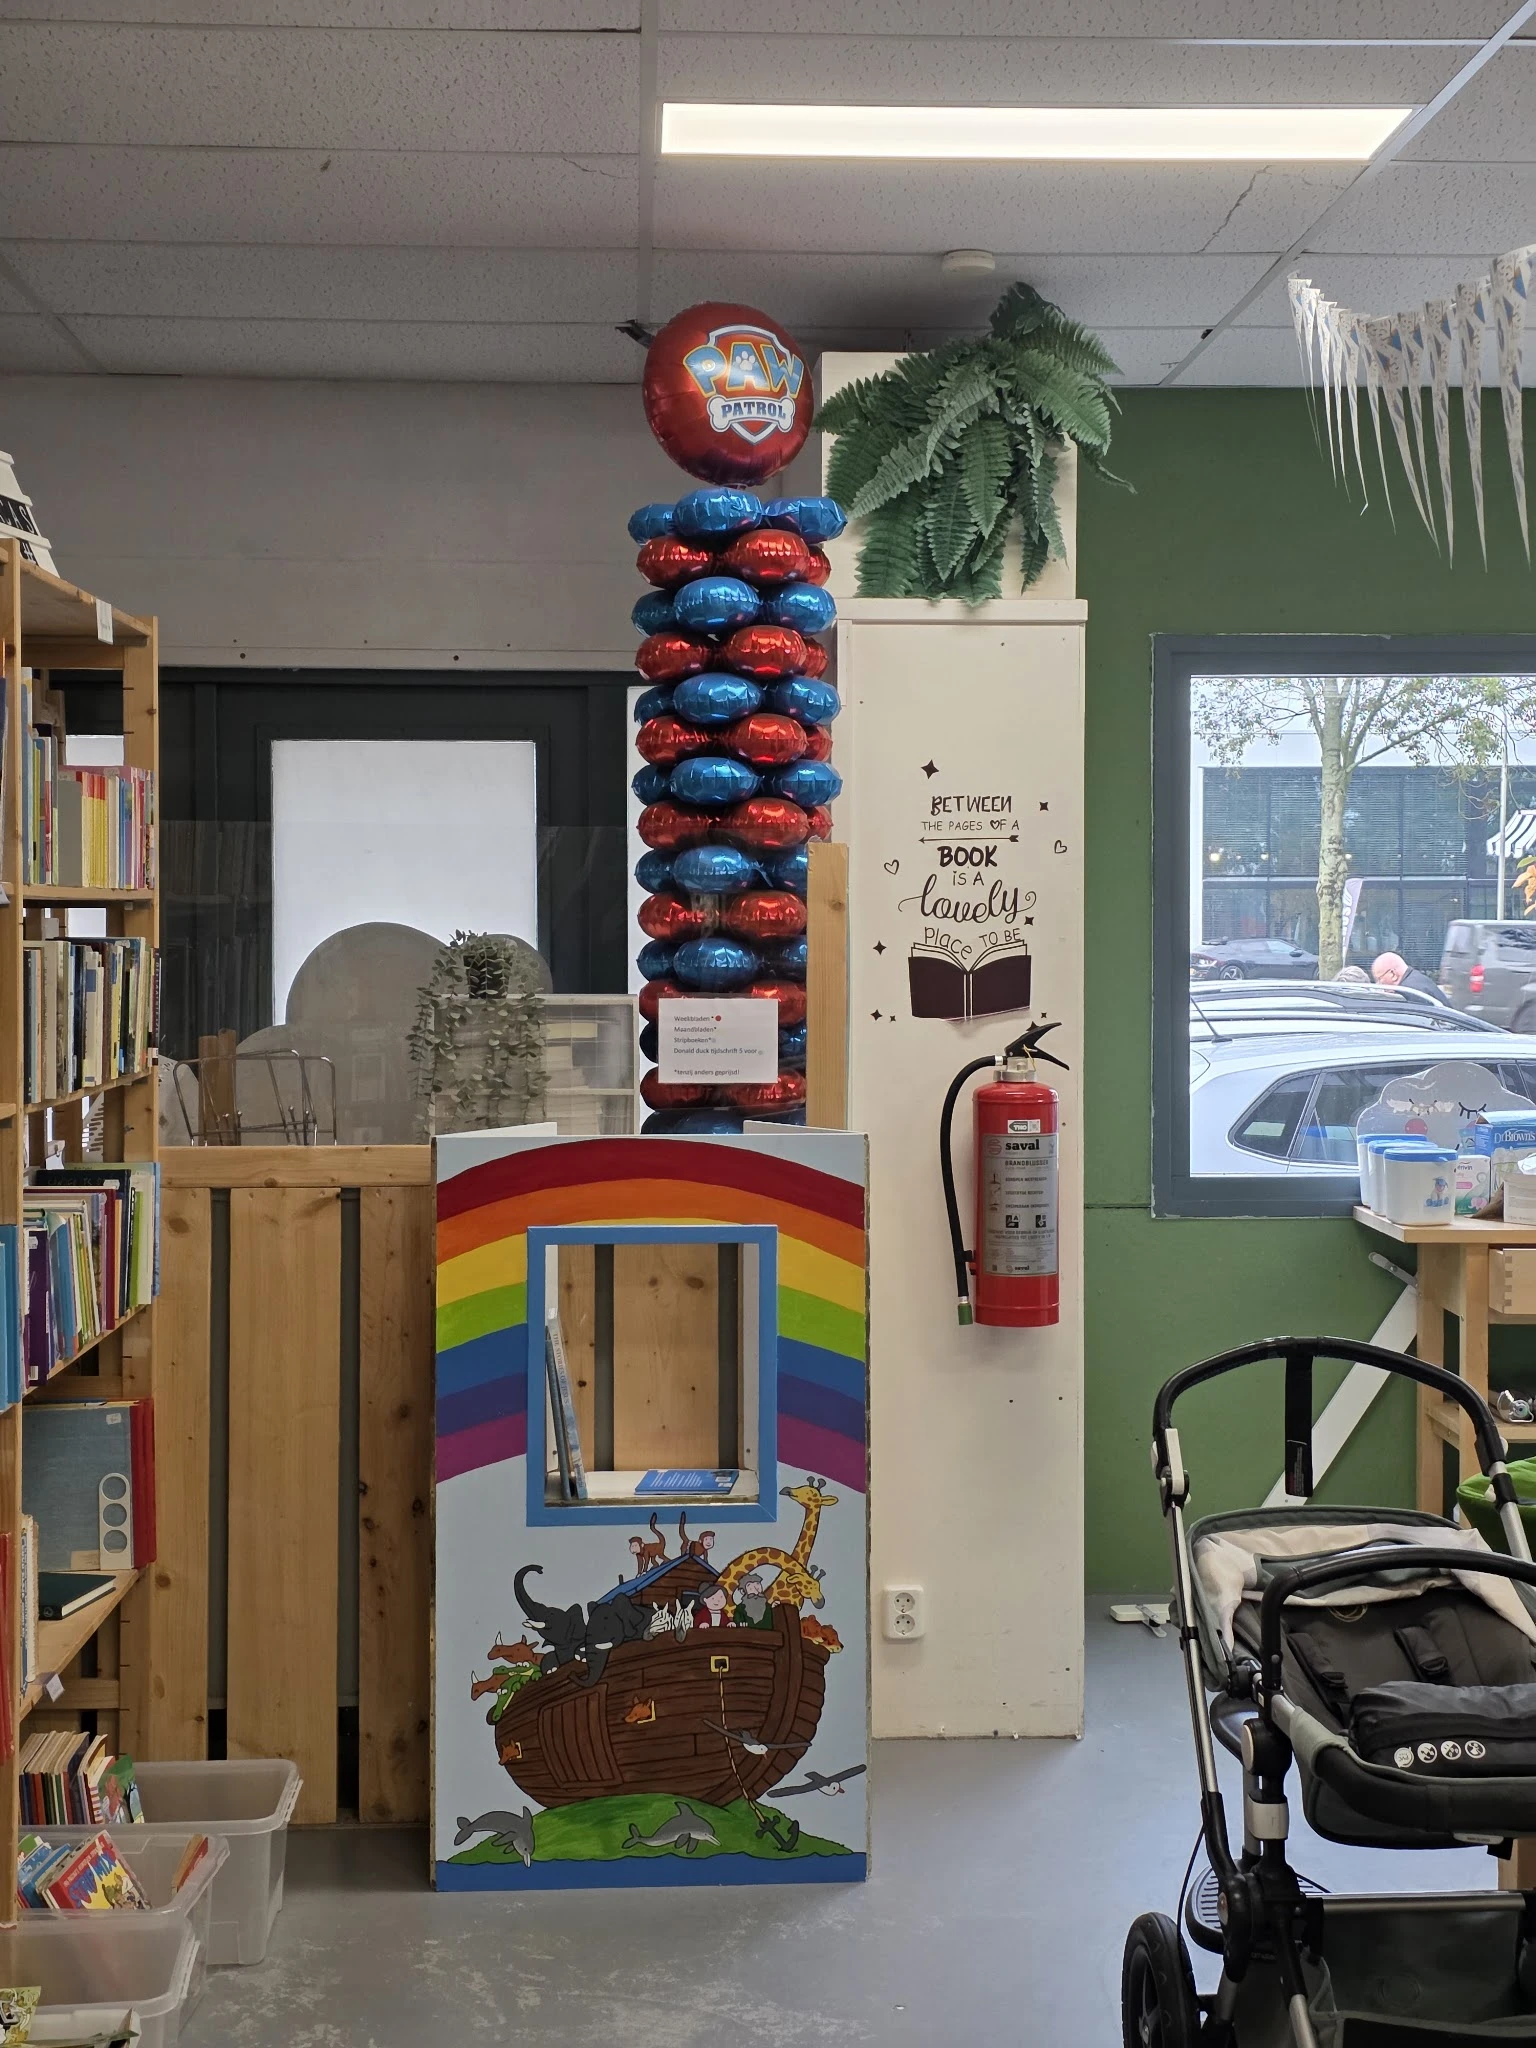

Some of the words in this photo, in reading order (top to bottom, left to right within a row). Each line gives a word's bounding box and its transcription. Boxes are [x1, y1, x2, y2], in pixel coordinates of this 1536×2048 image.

[682, 341, 804, 399] PAW
[721, 401, 787, 419] PATROL
[930, 795, 1012, 816] BETWEEN
[921, 820, 942, 831] THE
[948, 820, 983, 831] PAGES
[1011, 819, 1020, 831] A
[937, 845, 998, 867] BOOK
[973, 871, 984, 886] A
[898, 874, 1036, 924] lovely
[978, 931, 998, 948] TO
[1003, 927, 1022, 942] BE
[1005, 1139, 1040, 1151] saval
[555, 1347, 565, 1375] STORIES
[559, 1375, 566, 1383] OF
[560, 1385, 569, 1404] JESUS
